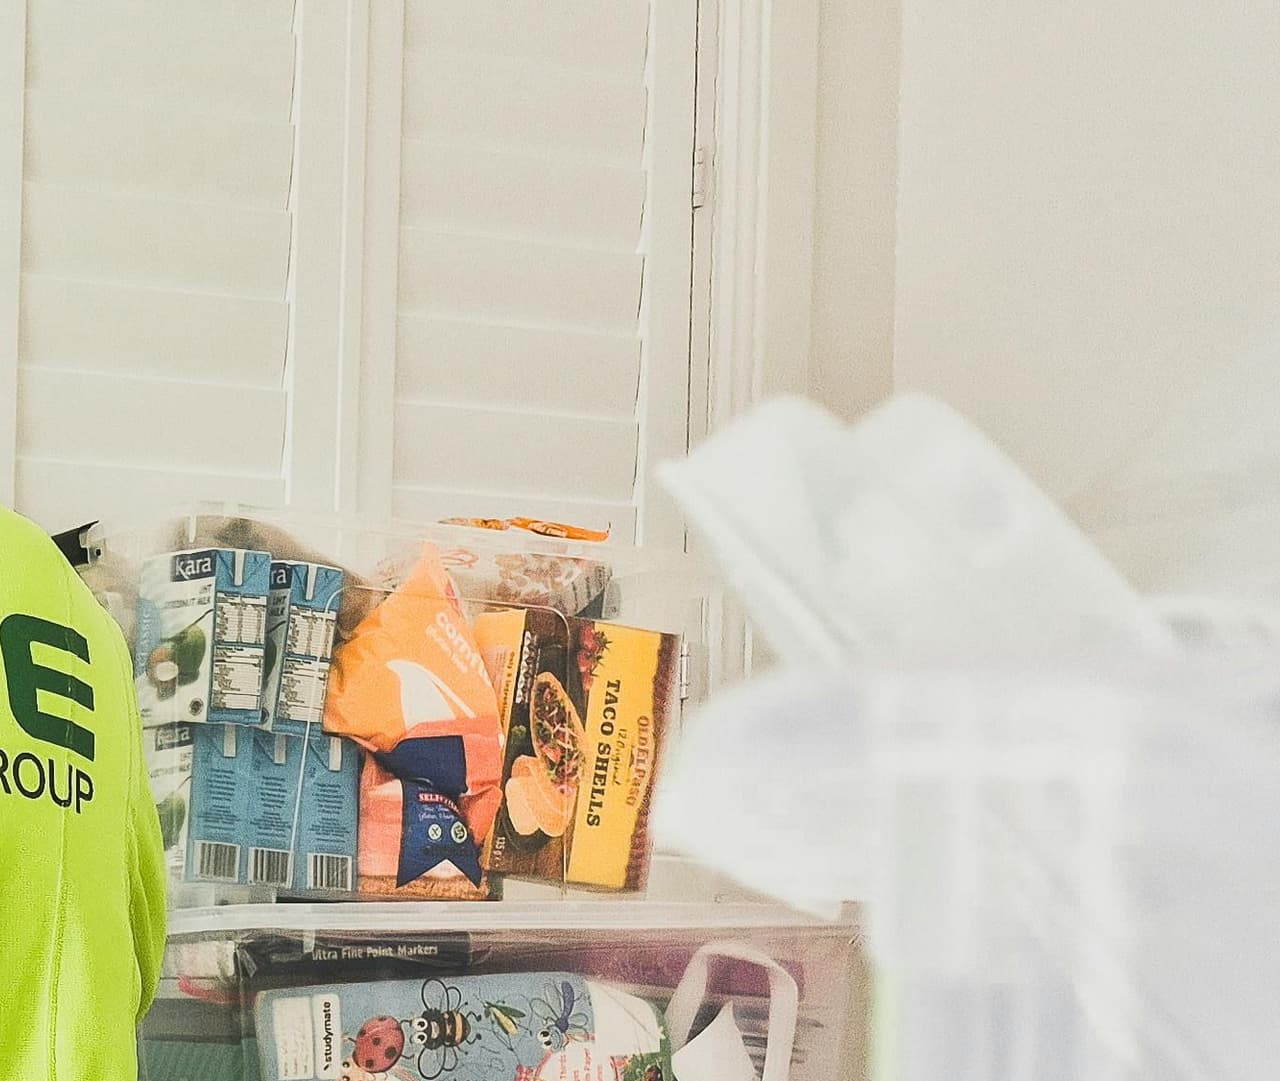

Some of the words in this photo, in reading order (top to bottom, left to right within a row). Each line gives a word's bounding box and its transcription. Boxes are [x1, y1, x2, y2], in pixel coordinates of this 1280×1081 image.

[175, 555, 212, 579] kara
[271, 568, 287, 584] ra
[600, 679, 621, 736] TACO
[586, 742, 612, 827] SHELLS
[342, 946, 363, 960] Fine
[398, 944, 438, 957] Markers
[323, 1001, 334, 1062] studymate
